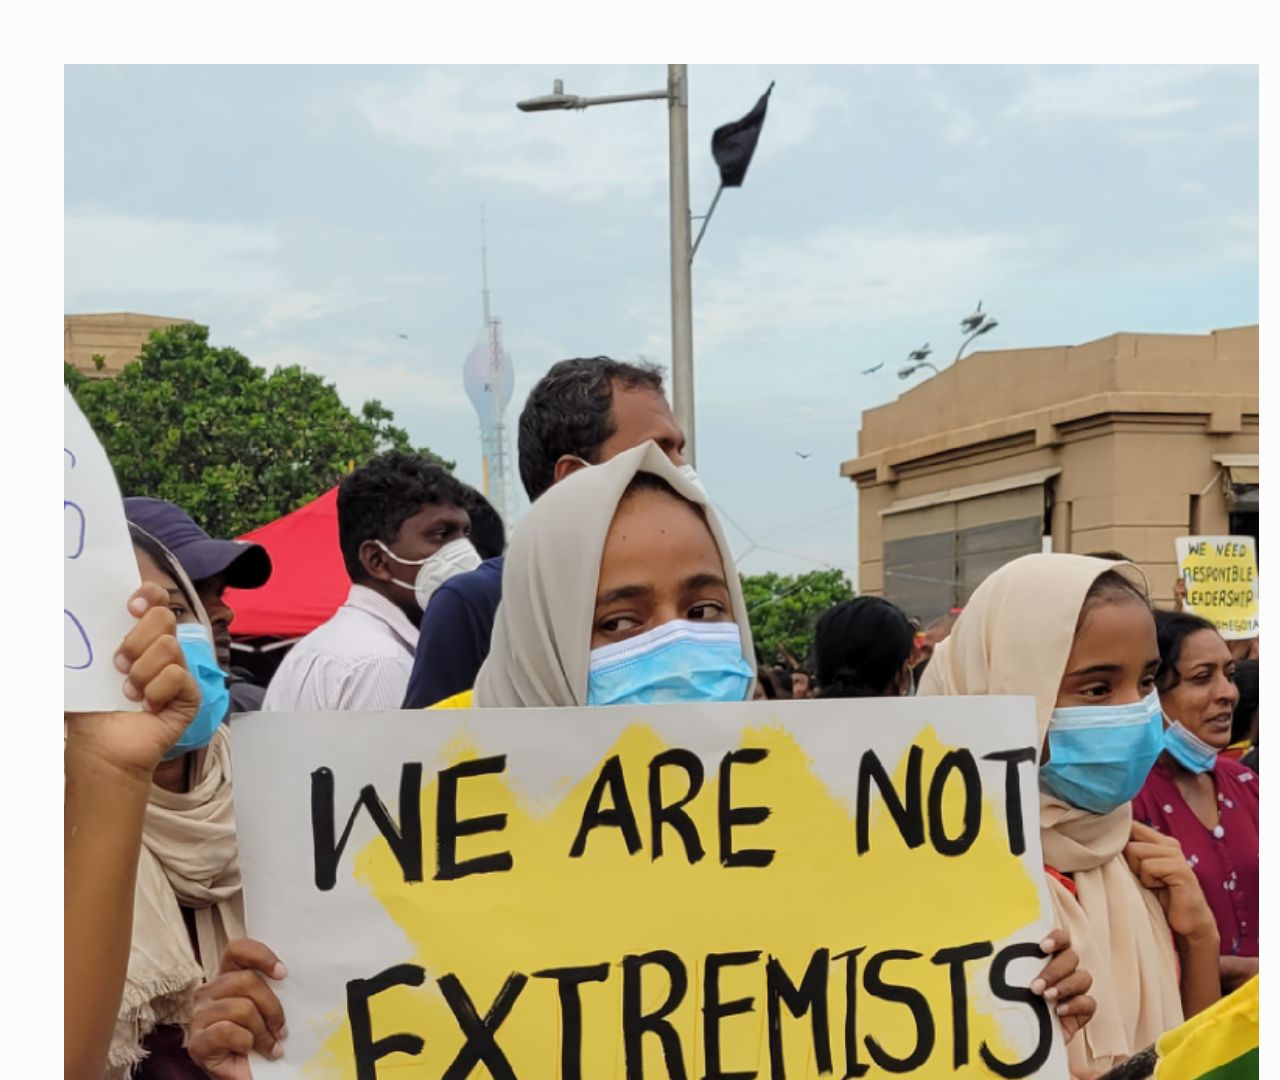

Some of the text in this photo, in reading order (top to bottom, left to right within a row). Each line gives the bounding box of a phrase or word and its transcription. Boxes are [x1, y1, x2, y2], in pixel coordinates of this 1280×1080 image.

[1188, 542, 1247, 557] WE NEED
[1186, 590, 1253, 608] LEADERSHIP
[311, 745, 1037, 892] WE ARE NOT
